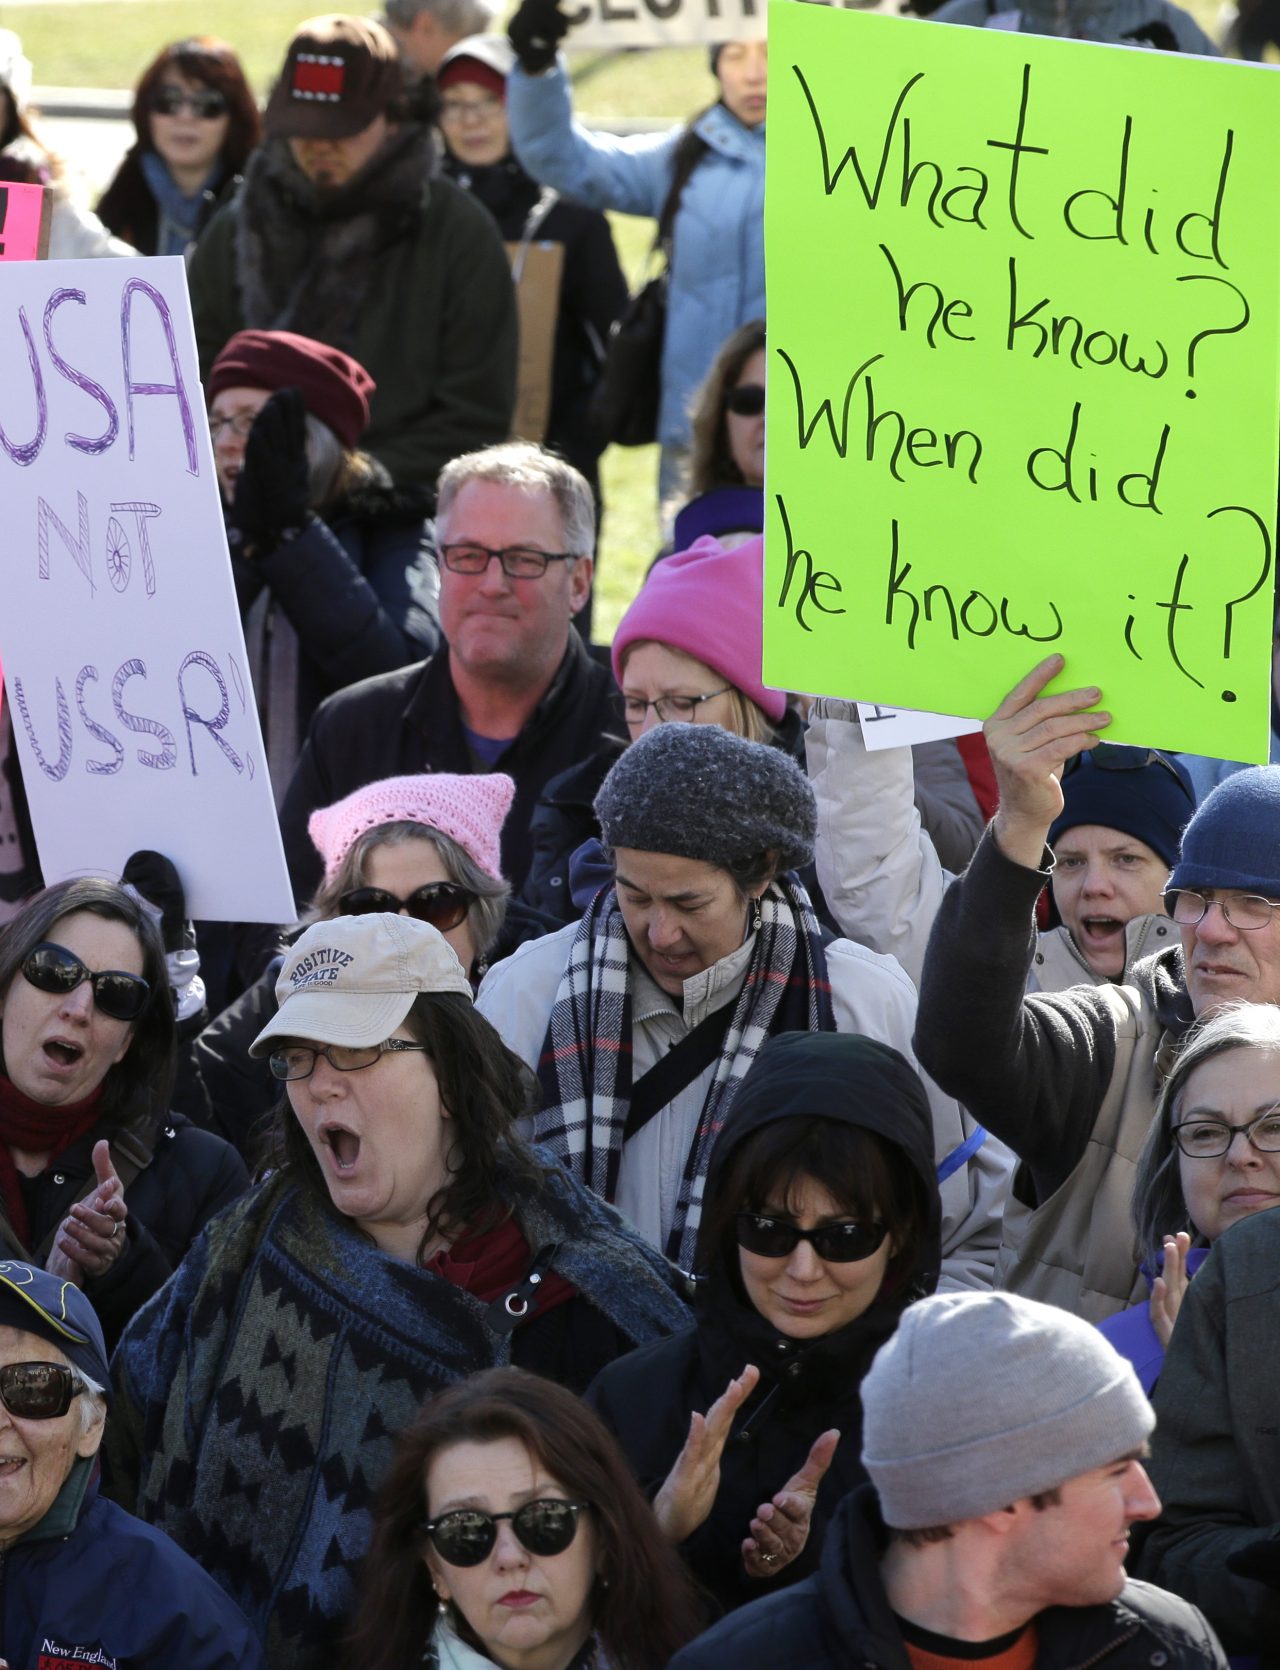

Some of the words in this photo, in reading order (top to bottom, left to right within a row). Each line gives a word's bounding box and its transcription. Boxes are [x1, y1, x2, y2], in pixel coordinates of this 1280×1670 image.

[792, 63, 1049, 241] What
[1063, 115, 1235, 270] did
[878, 243, 977, 349] he
[1006, 257, 1251, 400] know?
[775, 347, 983, 484] When
[1026, 401, 1171, 515] did
[37, 490, 163, 600] NOT
[775, 494, 847, 632] he
[885, 519, 1064, 650] know
[1123, 505, 1272, 703] it?
[289, 947, 355, 983] POSITIVE
[40, 1638, 72, 1657] New
